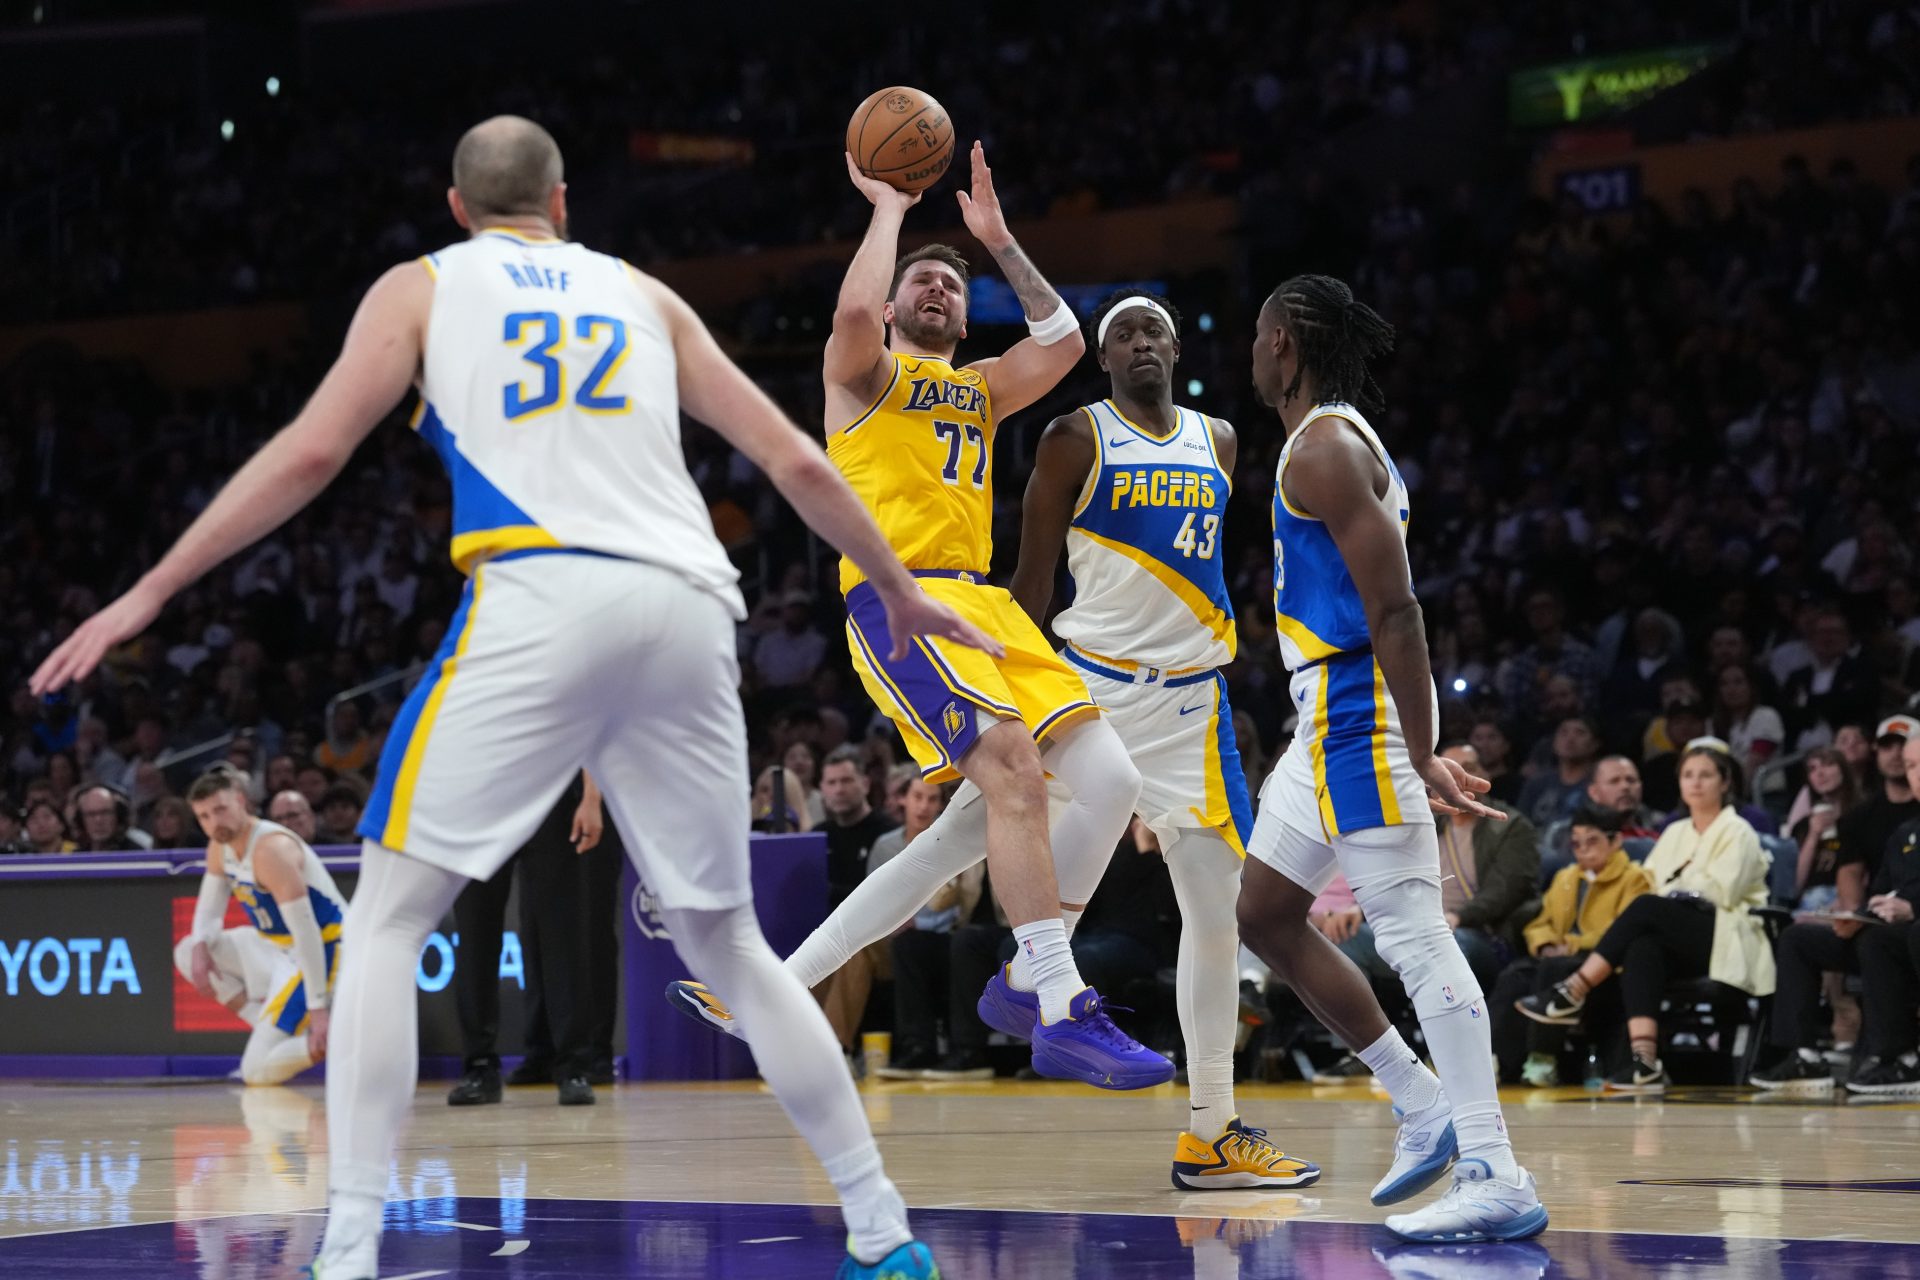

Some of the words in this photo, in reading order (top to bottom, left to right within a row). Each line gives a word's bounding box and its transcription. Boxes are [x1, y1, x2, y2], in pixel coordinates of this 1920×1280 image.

[502, 261, 570, 293] HUFF
[503, 311, 632, 424] 32
[901, 377, 987, 423] LAKERS
[933, 419, 988, 490] 77
[1183, 441, 1197, 450] LUCAS
[1111, 469, 1216, 511] PACERS
[1173, 512, 1220, 560] 43
